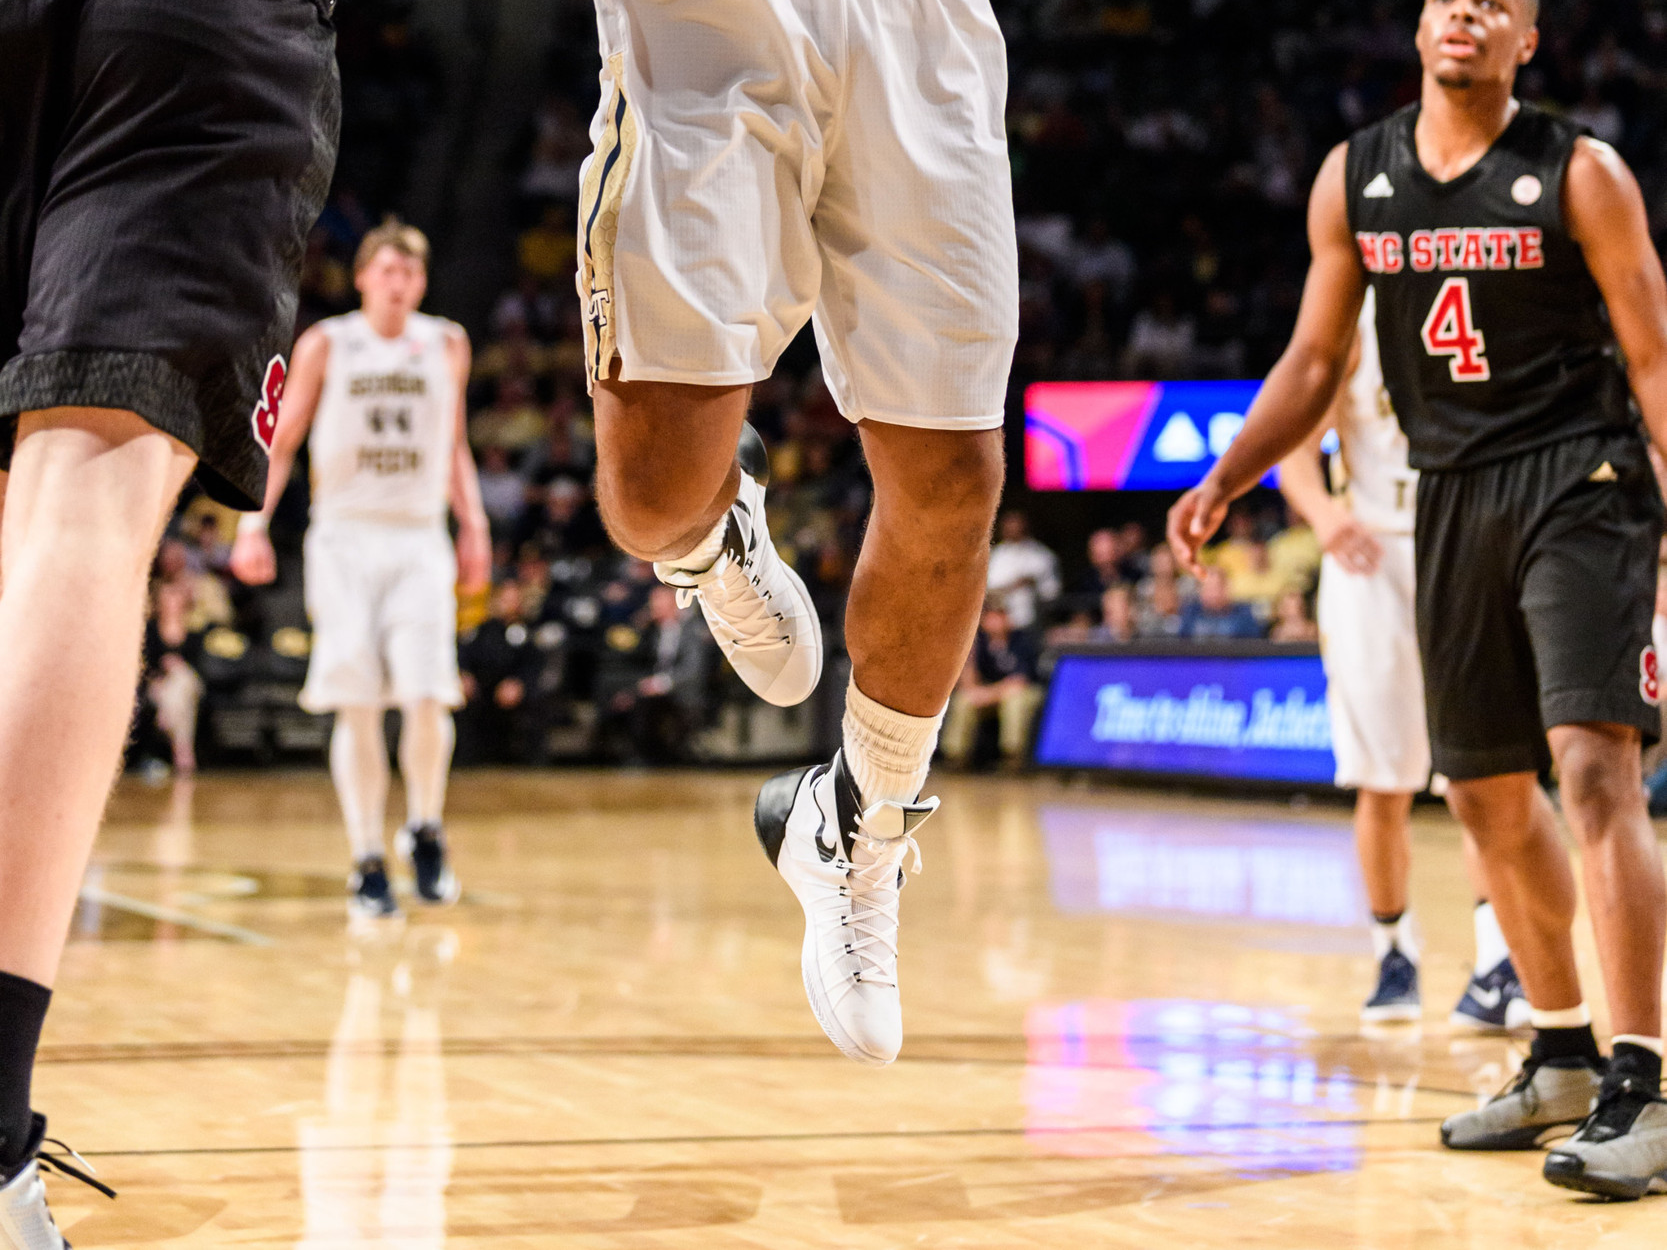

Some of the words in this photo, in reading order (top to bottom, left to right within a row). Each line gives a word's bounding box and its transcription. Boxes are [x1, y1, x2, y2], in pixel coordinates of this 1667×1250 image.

[1356, 231, 1403, 274] NC
[1409, 226, 1544, 273] STATE
[1421, 276, 1491, 383] 4
